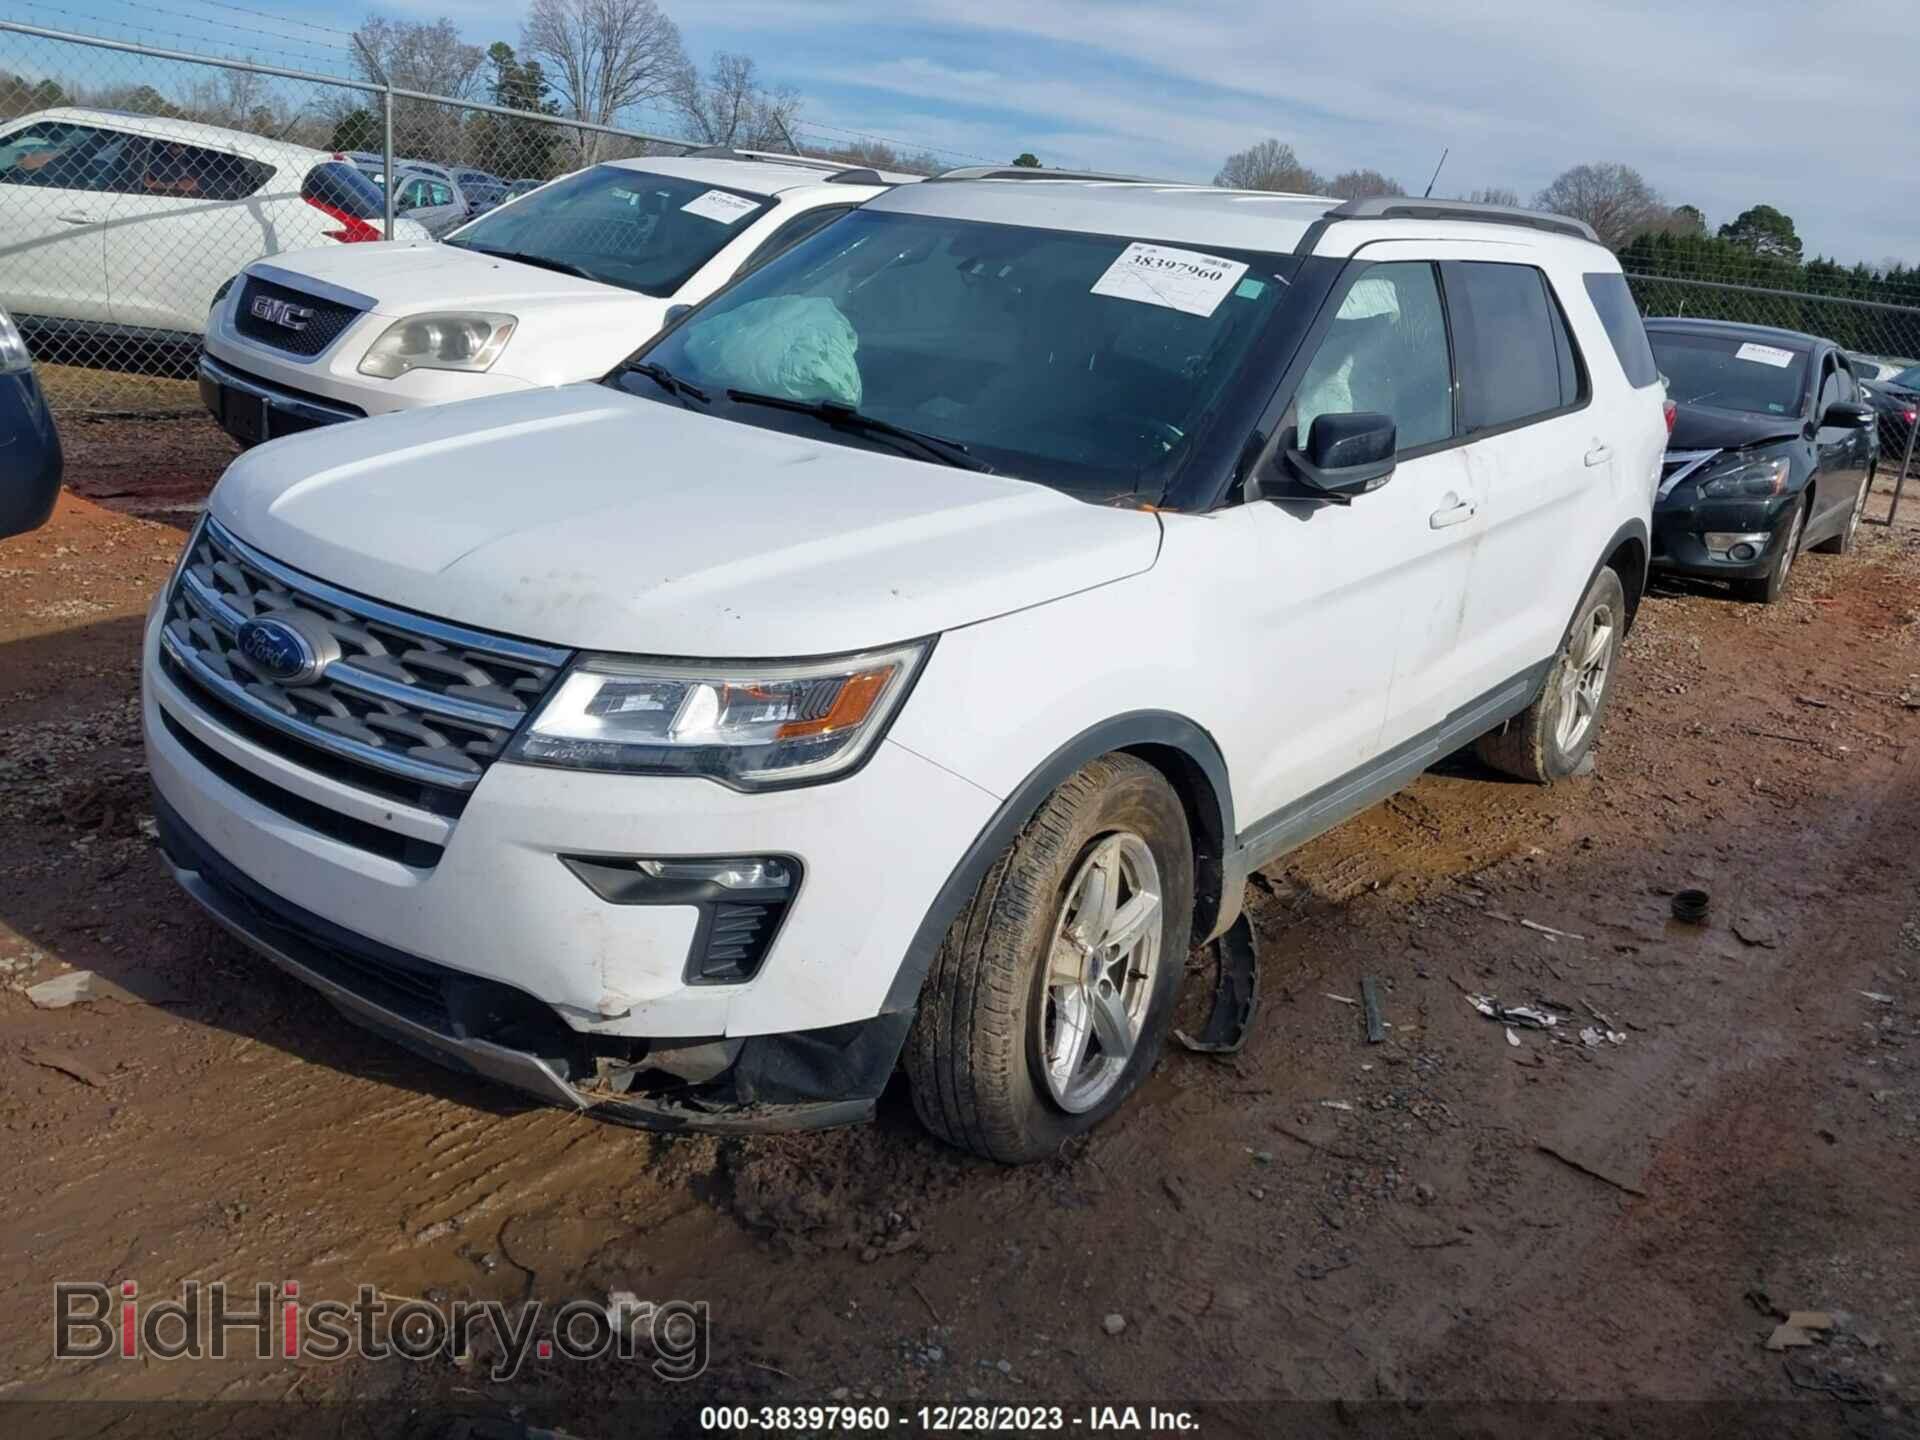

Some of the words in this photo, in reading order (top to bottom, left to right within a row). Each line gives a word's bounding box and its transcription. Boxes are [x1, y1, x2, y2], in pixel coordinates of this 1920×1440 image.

[1128, 255, 1223, 281] 38397960
[251, 296, 314, 330] GMC
[244, 626, 289, 669] Ford
